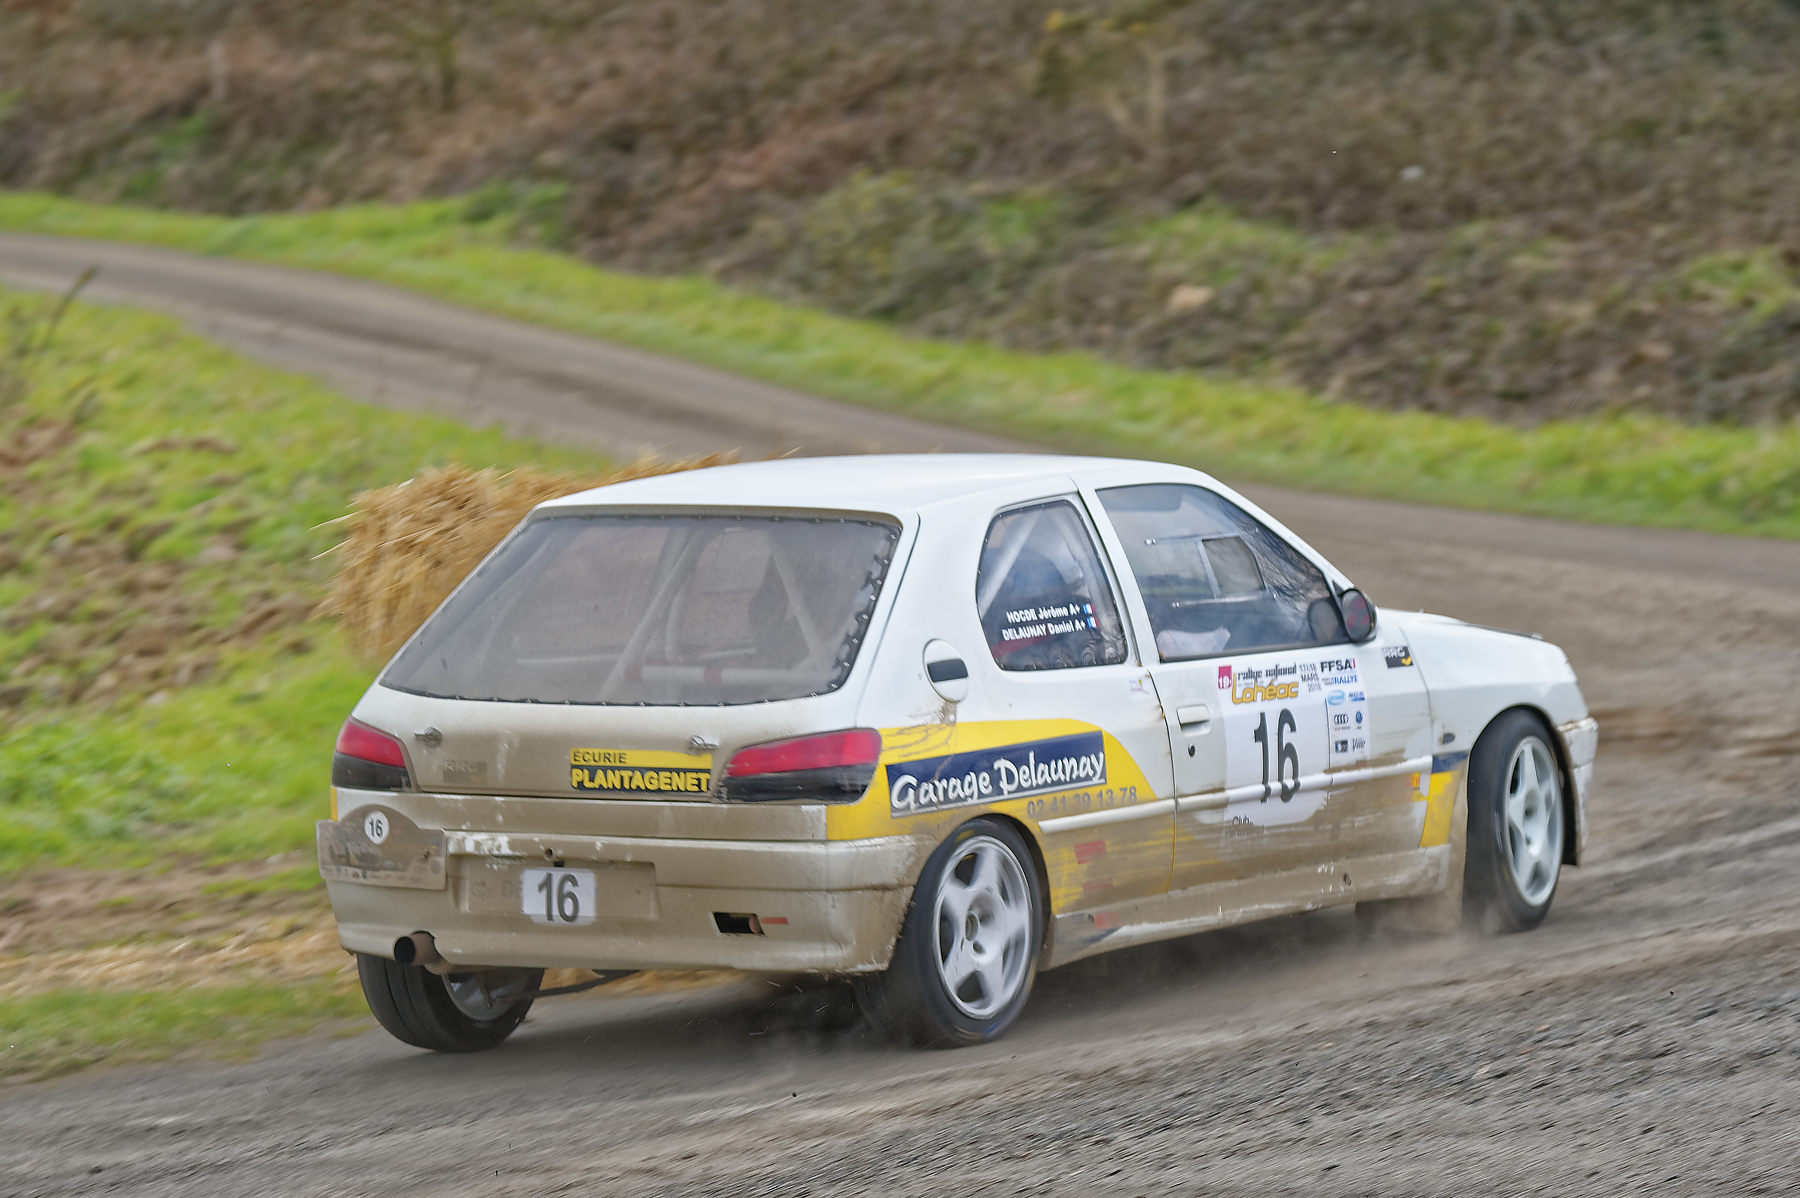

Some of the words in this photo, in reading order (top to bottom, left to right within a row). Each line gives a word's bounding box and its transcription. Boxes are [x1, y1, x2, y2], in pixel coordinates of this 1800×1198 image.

[1002, 623, 1047, 641] DELAUNAY
[1047, 620, 1074, 635] Daniel
[1320, 660, 1353, 673] FFSA
[1232, 672, 1299, 705] Lohéac
[1253, 708, 1301, 804] 16
[571, 767, 711, 792] PLANTAGENET
[890, 770, 993, 812] Garage
[993, 750, 1105, 796] Delaunay
[1027, 799, 1046, 819] 02
[1050, 796, 1066, 814] 41
[1097, 790, 1115, 808] 13
[1119, 786, 1138, 804] 78
[368, 819, 384, 838] 16
[537, 871, 580, 923] 16
